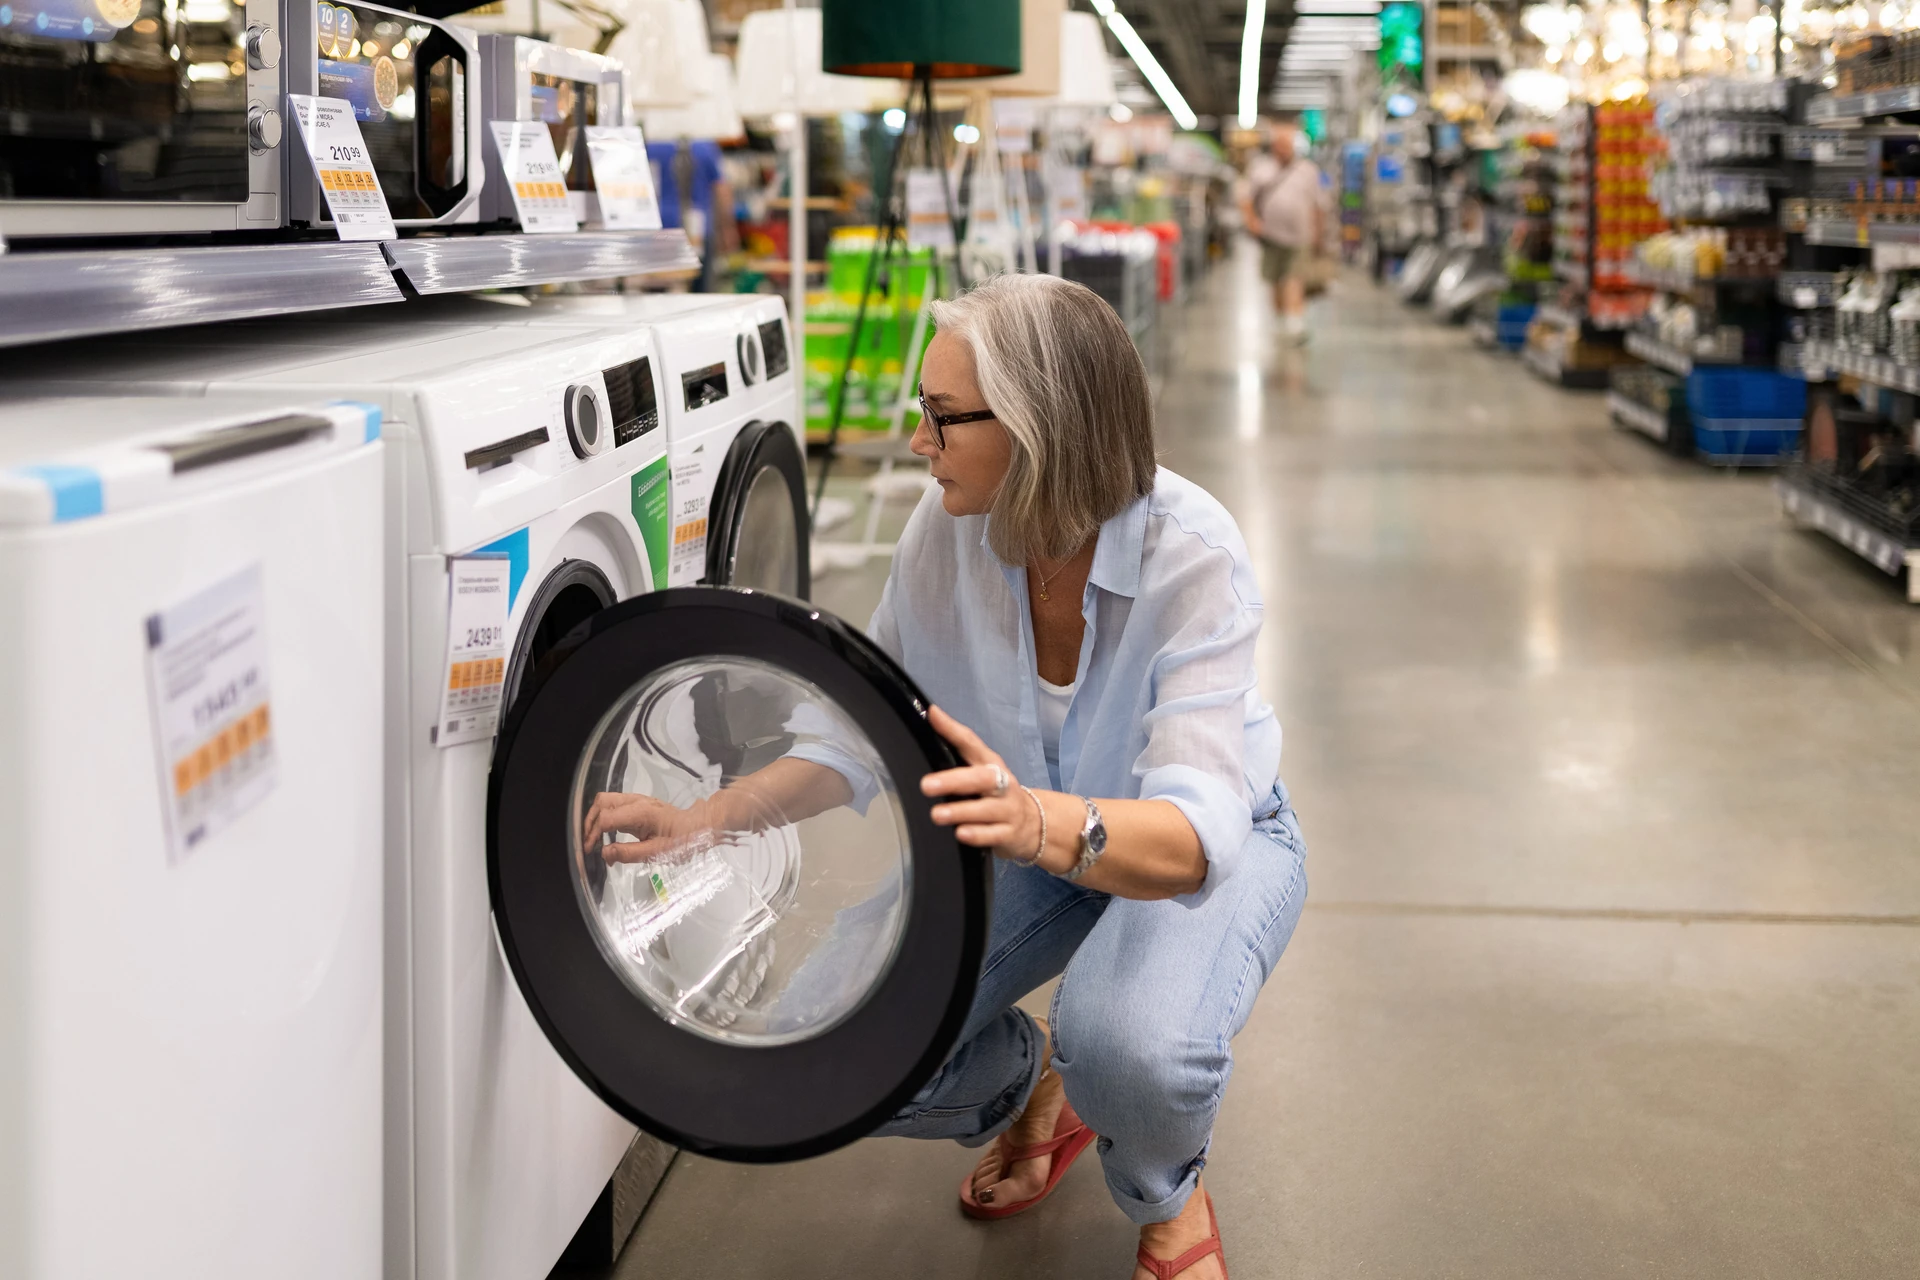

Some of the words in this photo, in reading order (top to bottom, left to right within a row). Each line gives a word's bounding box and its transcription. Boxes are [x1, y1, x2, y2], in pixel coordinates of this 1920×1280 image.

[321, 7, 333, 25] 10
[340, 12, 348, 29] 2
[329, 145, 351, 161] 210
[350, 146, 361, 158] 99
[355, 174, 364, 183] 24
[365, 174, 374, 184] 36
[683, 497, 700, 515] 3293
[466, 627, 492, 648] 2439
[493, 625, 502, 640] 01
